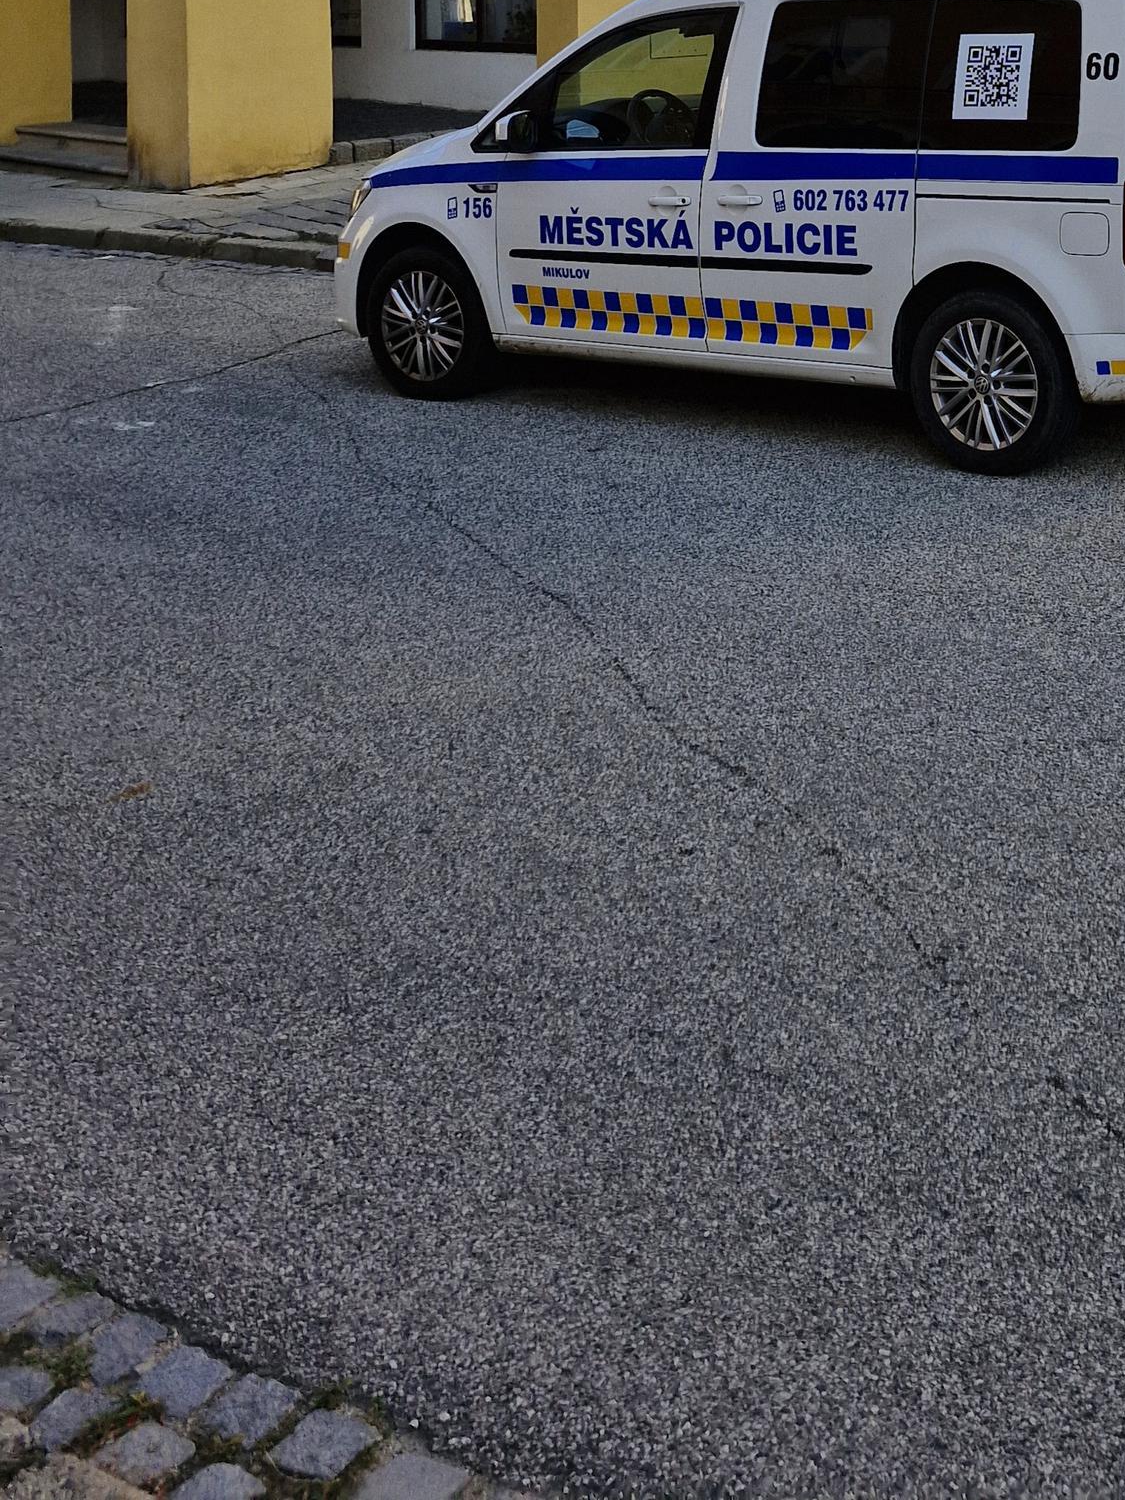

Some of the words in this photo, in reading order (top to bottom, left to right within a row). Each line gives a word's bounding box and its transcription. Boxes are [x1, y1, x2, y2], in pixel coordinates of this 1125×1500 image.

[1086, 52, 1120, 80] 60
[463, 197, 493, 218] 156
[793, 189, 827, 211] 602
[833, 189, 868, 212] 763
[873, 190, 909, 212] 477
[539, 206, 693, 249] MĚSTSKÁ
[714, 220, 858, 256] POLICIE
[542, 266, 590, 279] MIKULOV
